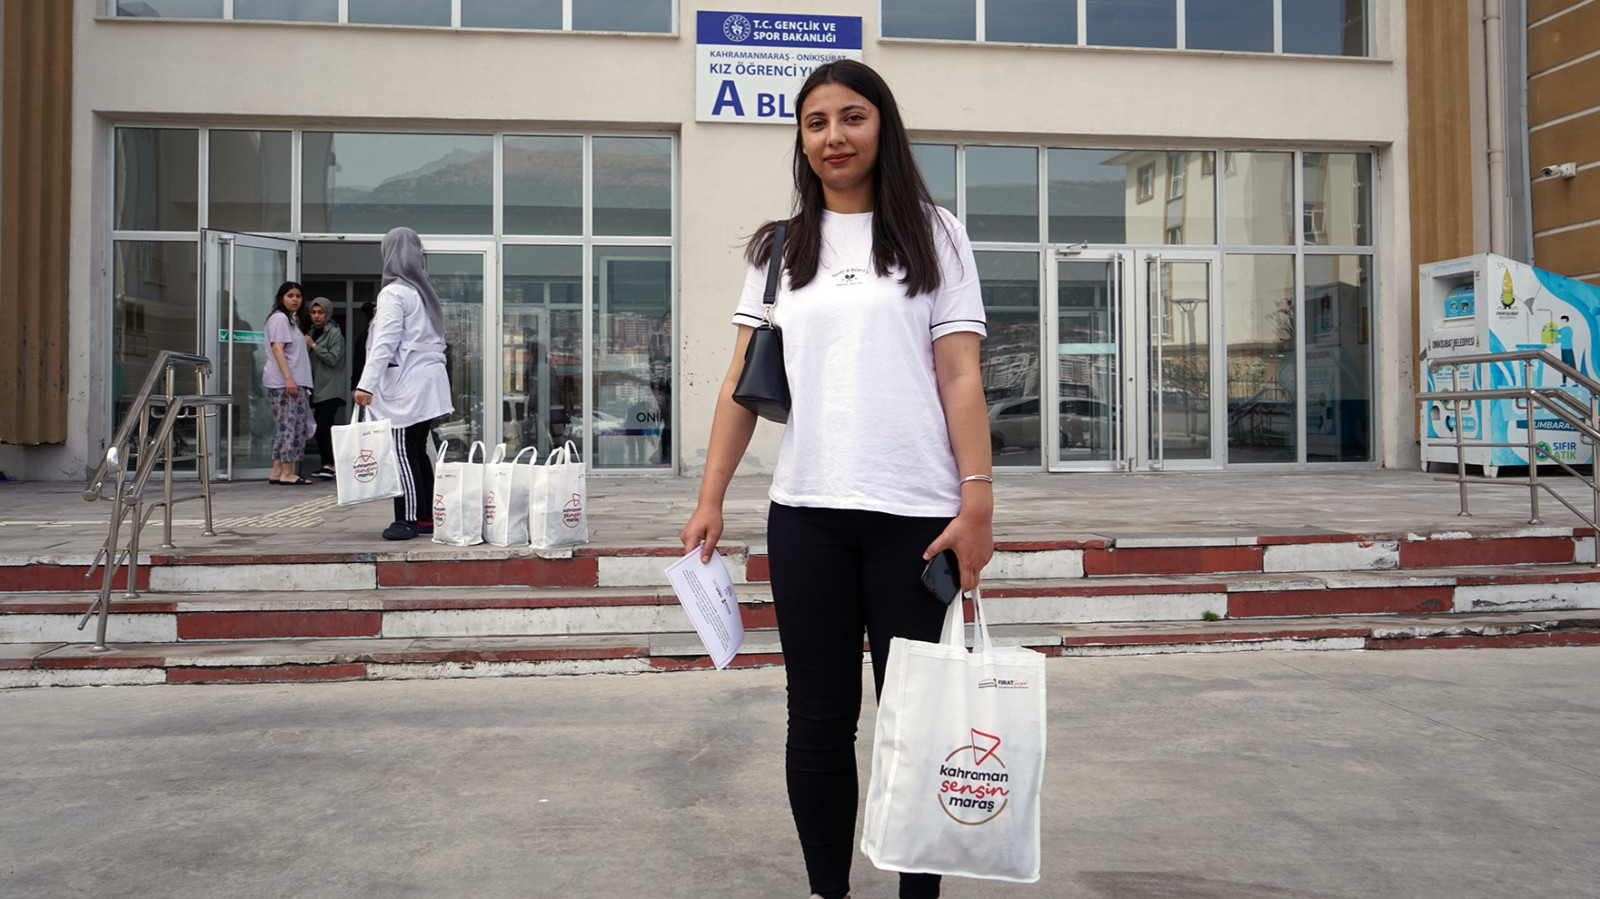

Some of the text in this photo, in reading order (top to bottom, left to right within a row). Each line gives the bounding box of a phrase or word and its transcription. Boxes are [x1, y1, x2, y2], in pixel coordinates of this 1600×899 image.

[753, 20, 836, 32] T.C. GENÇLİK VE
[753, 32, 836, 43] SPOR BAKANLIĞI
[709, 51, 790, 61] KAHRAMANMARAŞ
[709, 63, 732, 74] KIZ
[735, 62, 797, 77] ÖĞRENCİ
[712, 80, 794, 118] A BL
[1553, 442, 1577, 451] SIFIR
[939, 764, 1009, 783] kahraman
[940, 780, 1010, 800] sensin
[949, 796, 995, 812] maraş
